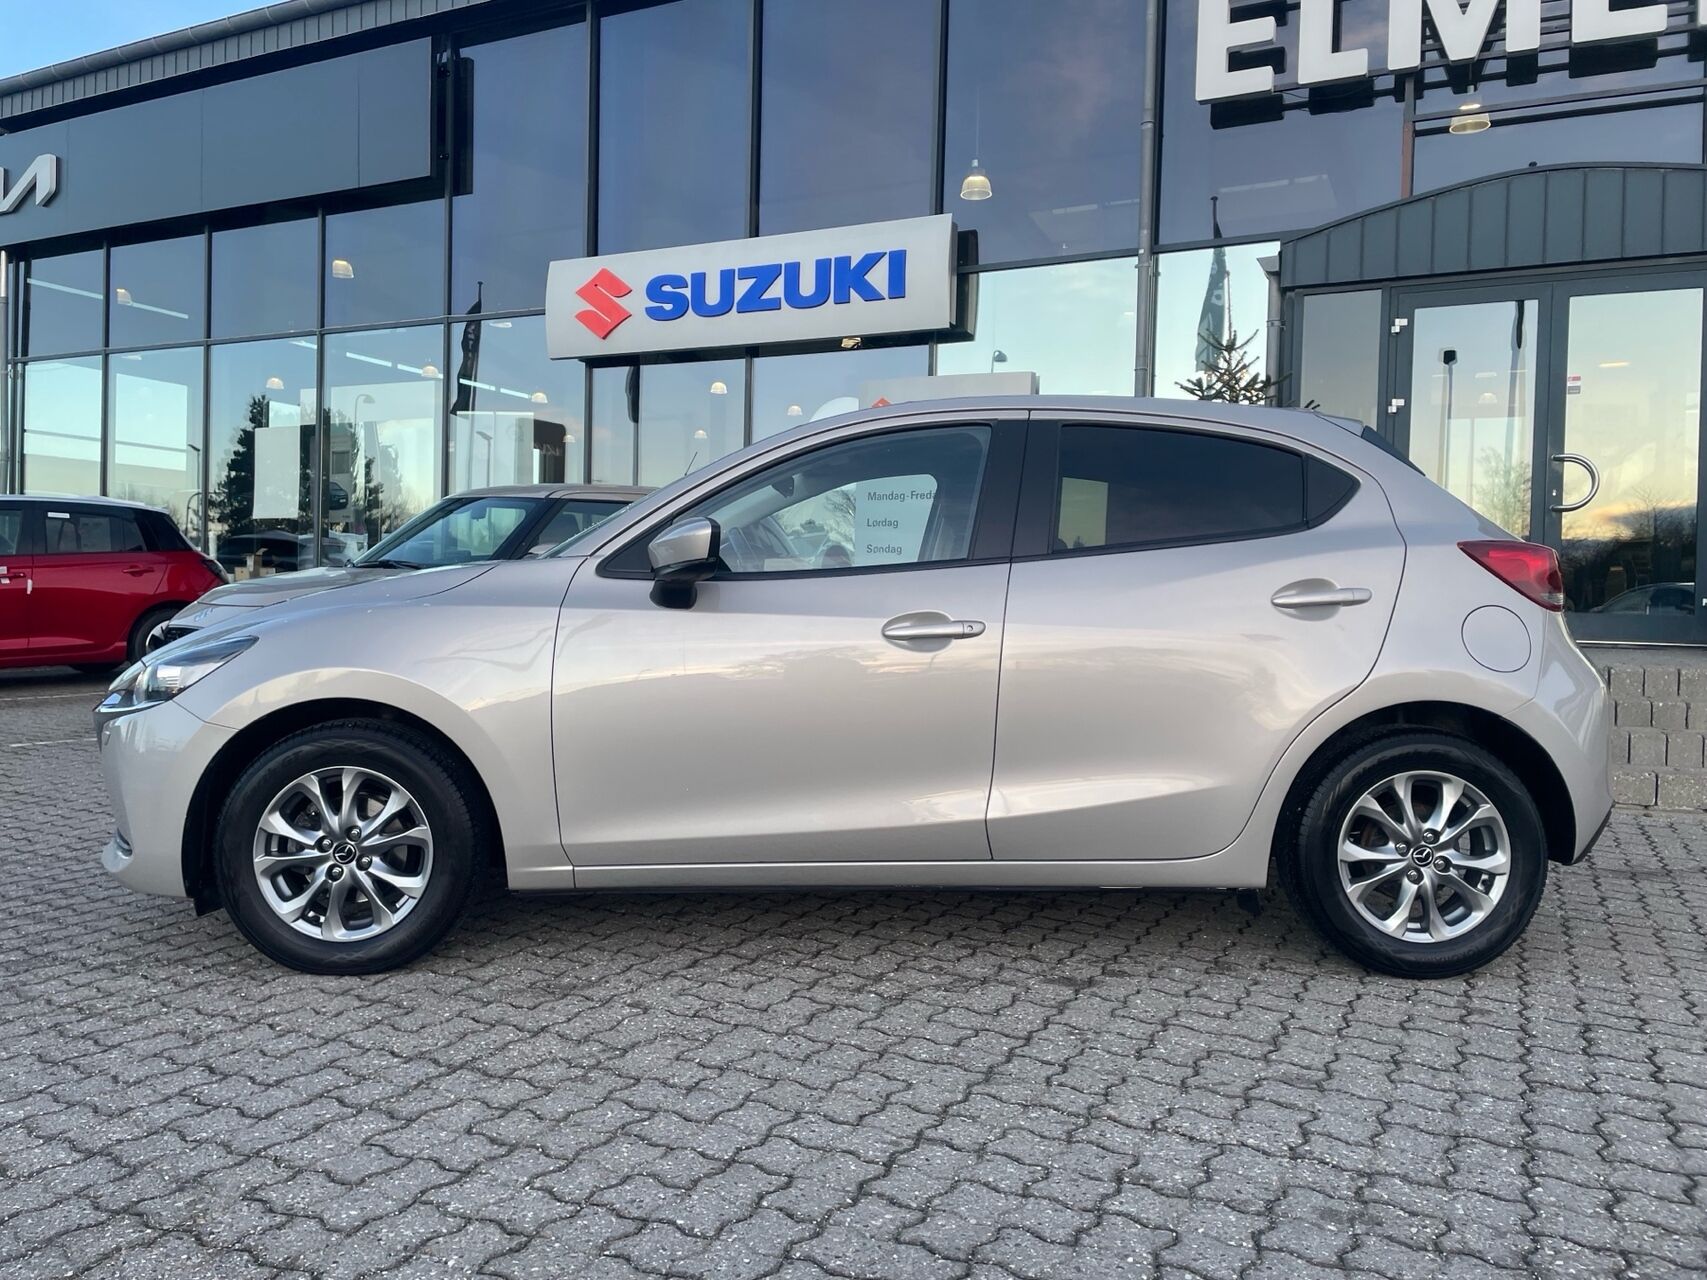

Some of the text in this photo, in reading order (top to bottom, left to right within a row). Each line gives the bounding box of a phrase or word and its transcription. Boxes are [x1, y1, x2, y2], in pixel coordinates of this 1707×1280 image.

[645, 249, 907, 322] SUZUKI
[867, 518, 898, 528] Lørdag
[866, 544, 902, 555] Søndag
